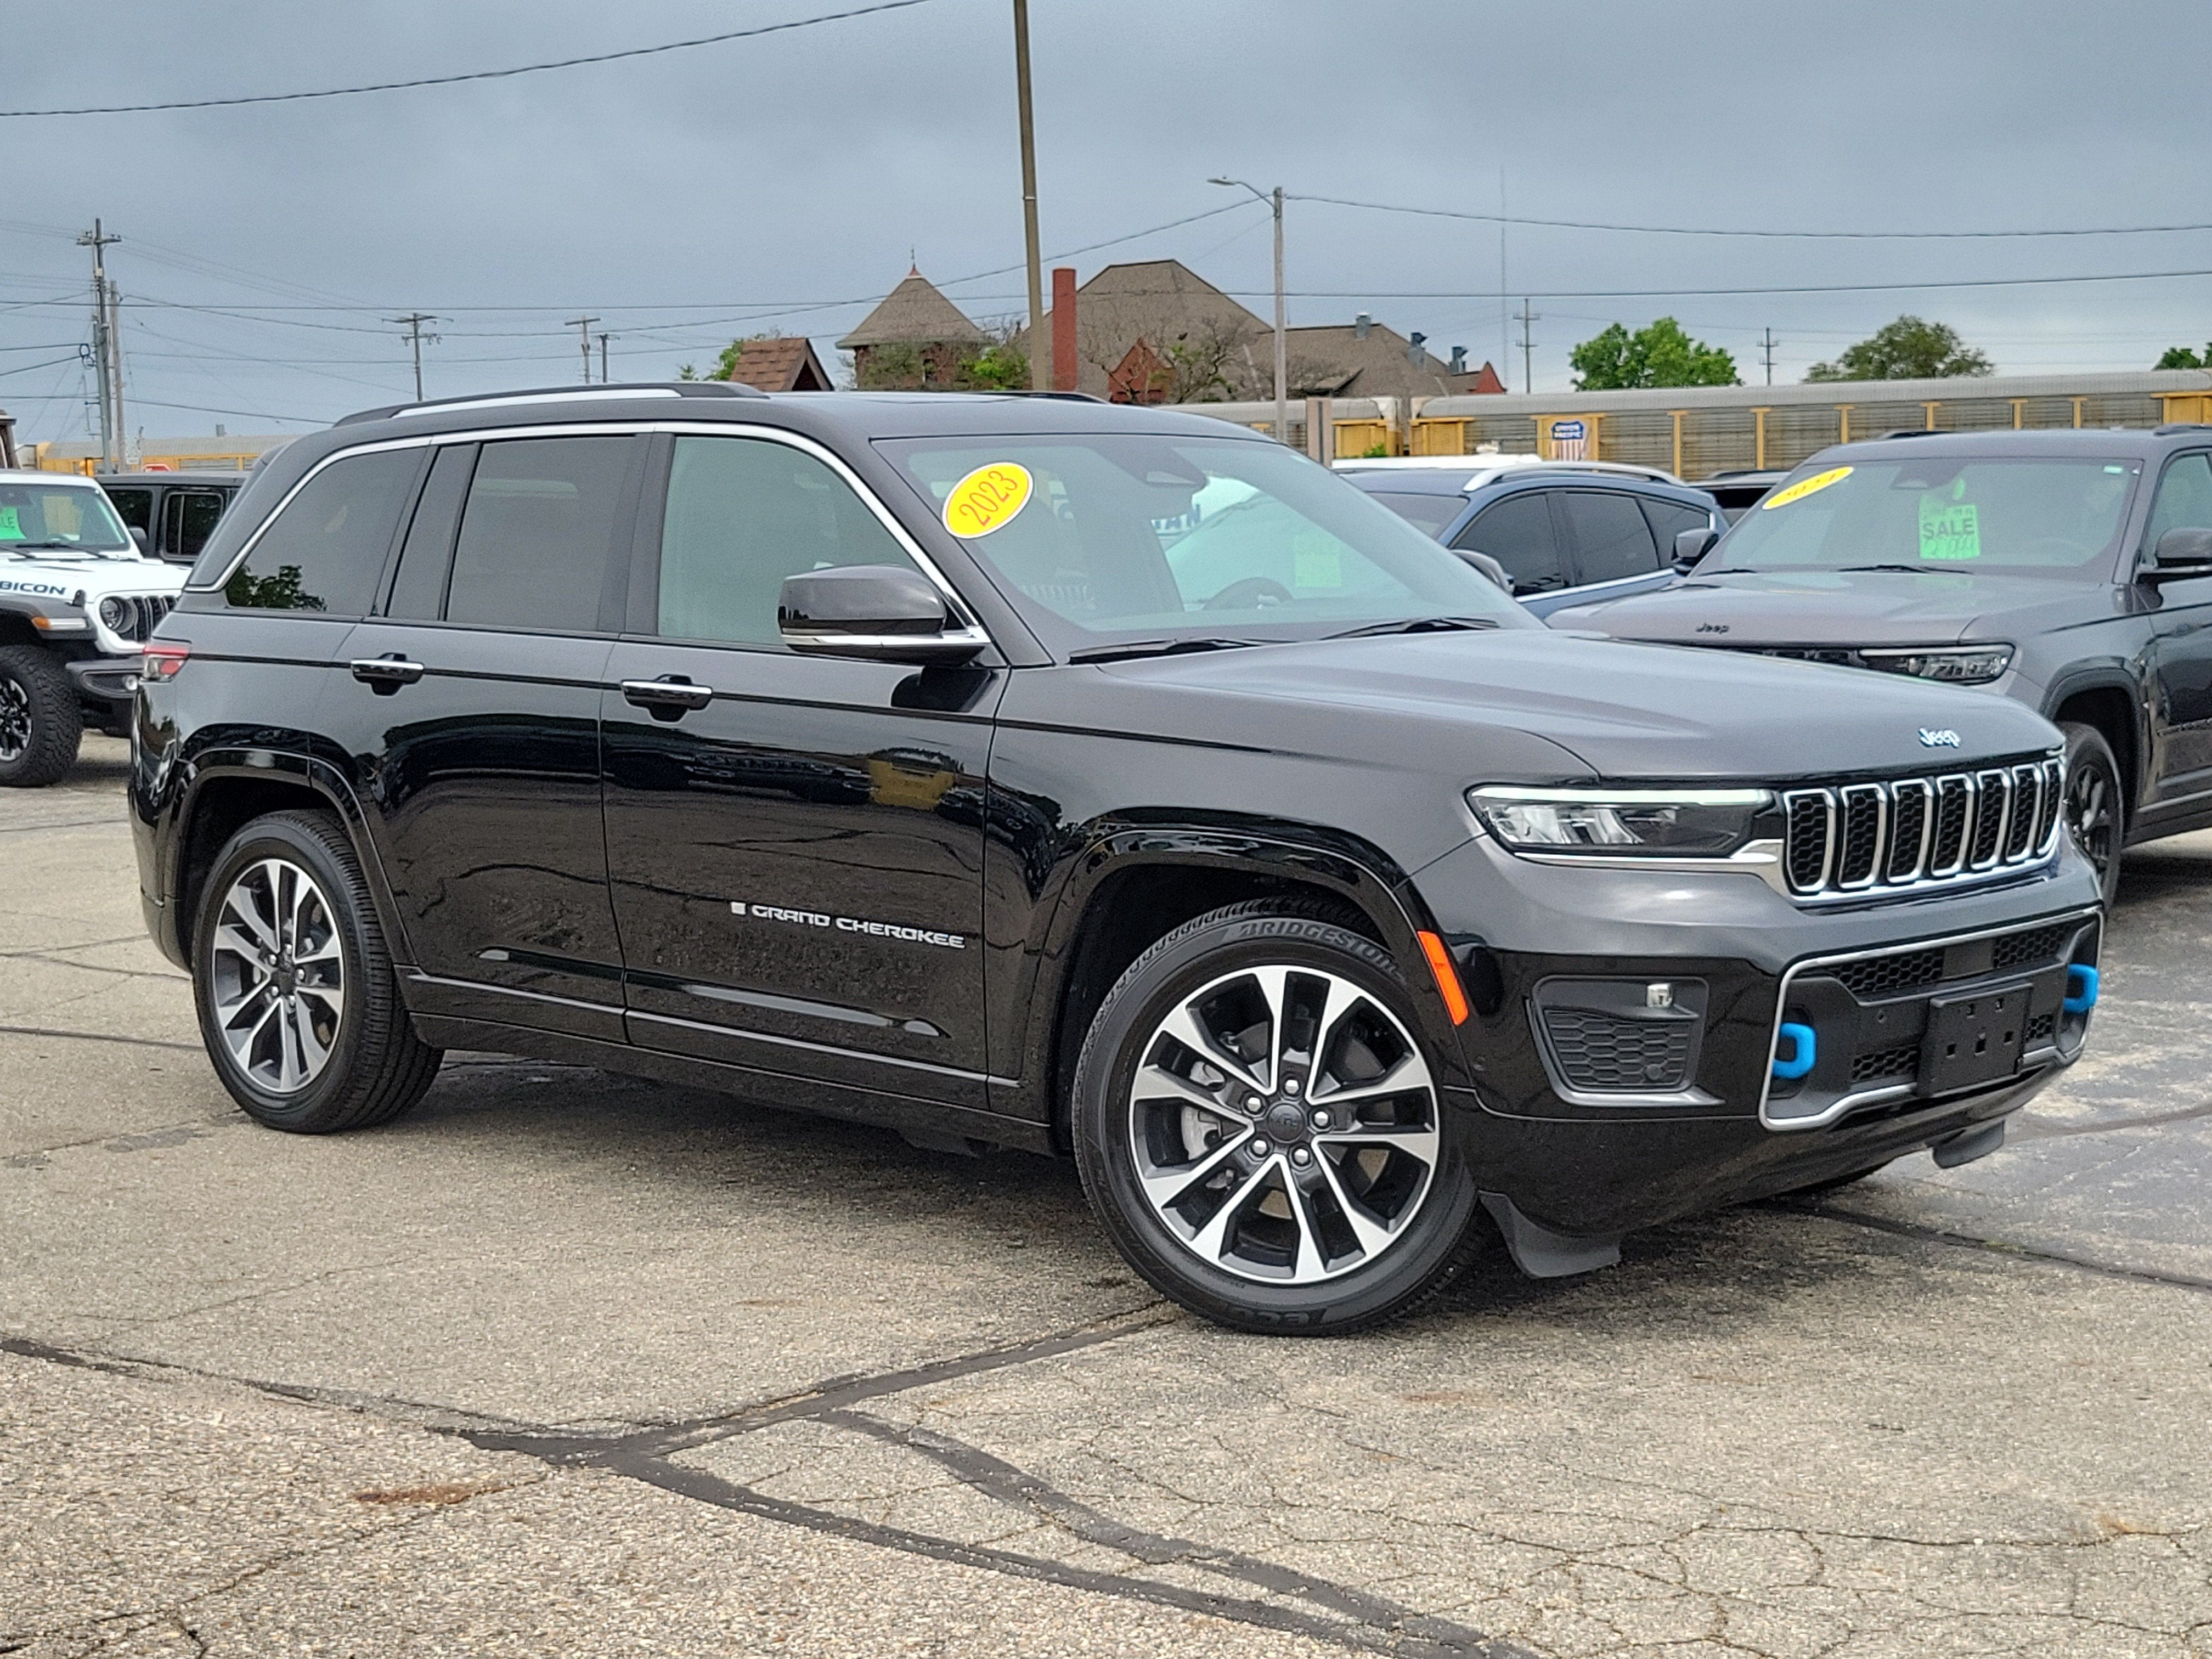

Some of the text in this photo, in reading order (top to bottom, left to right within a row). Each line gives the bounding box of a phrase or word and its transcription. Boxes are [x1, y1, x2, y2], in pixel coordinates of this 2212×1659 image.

[959, 471, 1018, 527] 2023
[1922, 518, 1975, 539] SALE
[1696, 622, 1730, 635] Jeep
[1918, 727, 1960, 749] Jeep
[751, 905, 966, 949] GRAND CHEROKEE
